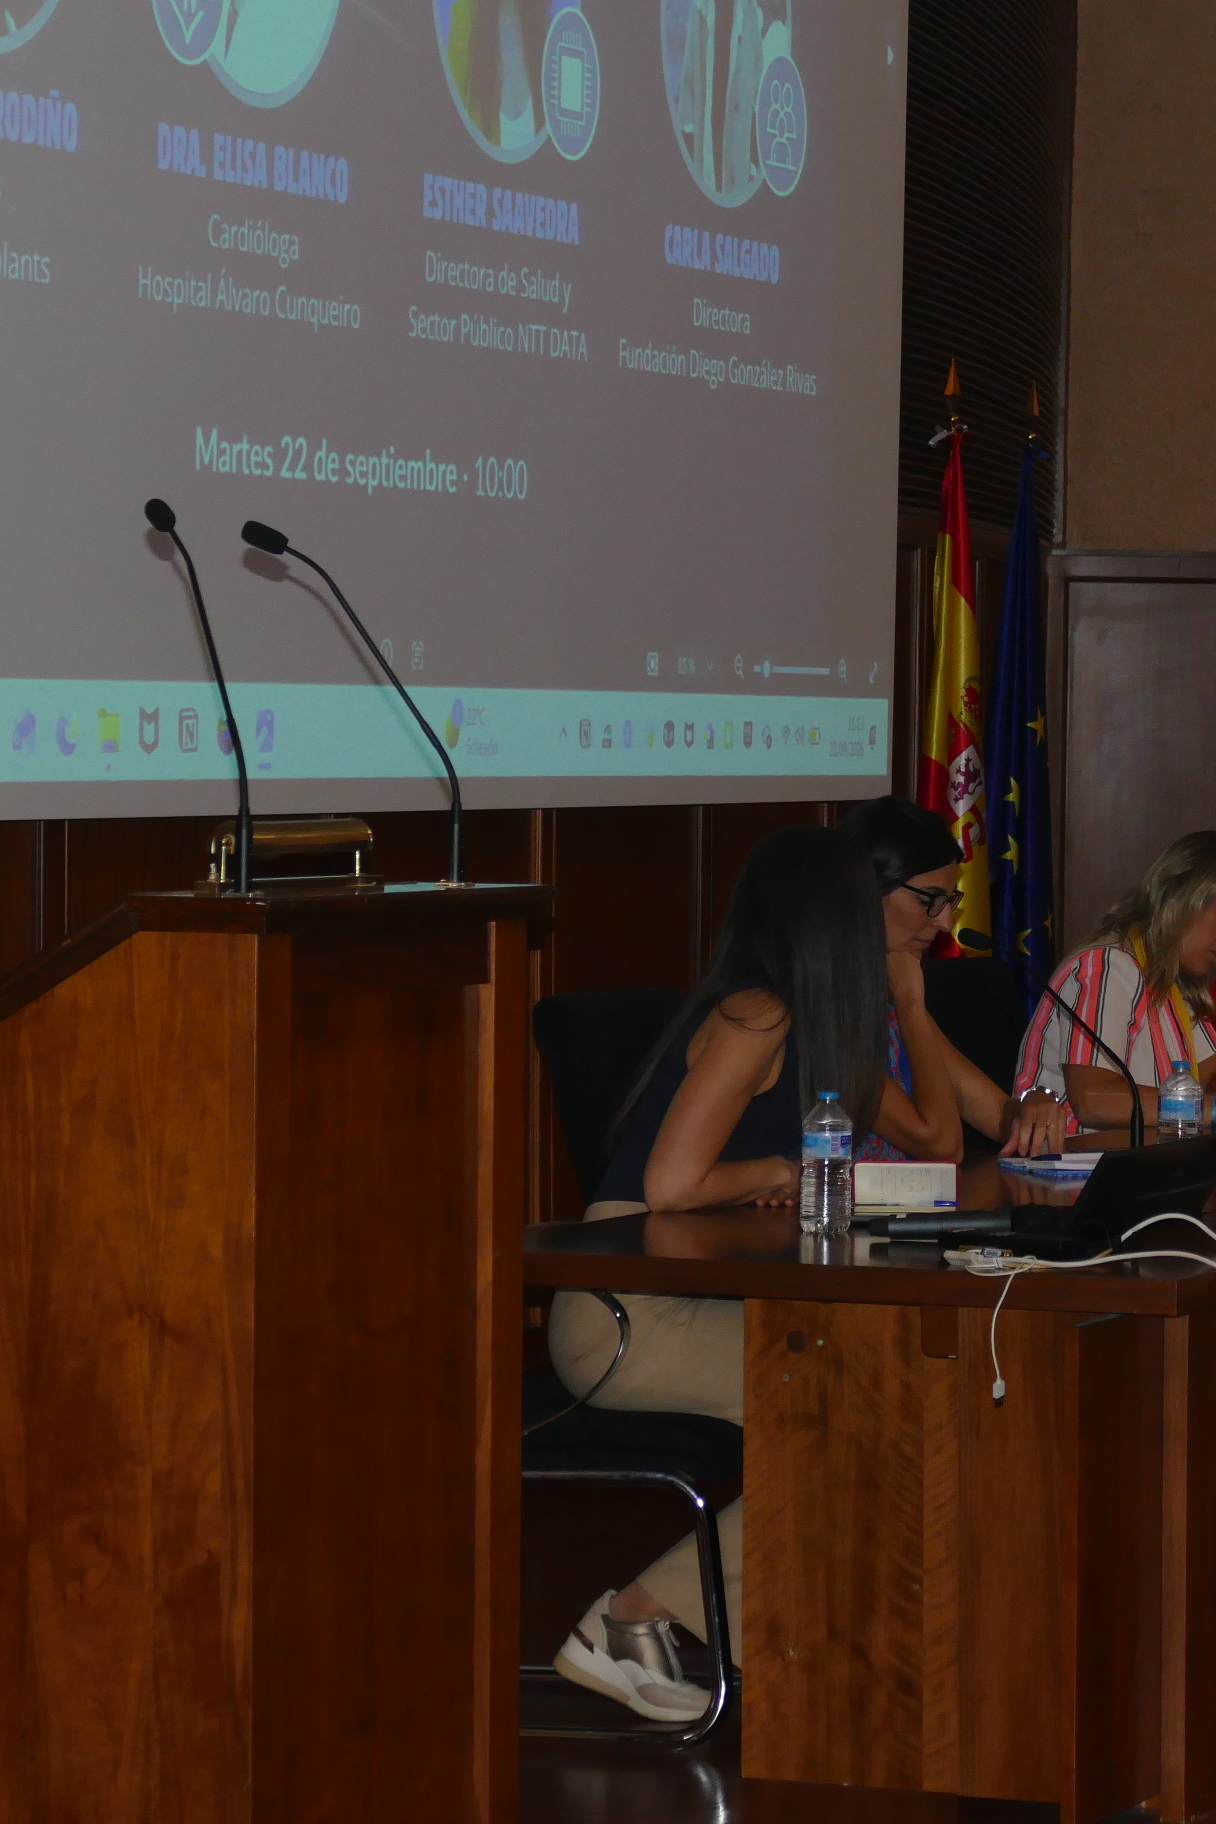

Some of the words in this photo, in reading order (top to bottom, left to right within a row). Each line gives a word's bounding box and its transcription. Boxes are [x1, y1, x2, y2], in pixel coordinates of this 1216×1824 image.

[0, 88, 79, 152] ODIÑO
[157, 122, 207, 177] DRA.
[213, 133, 268, 189] ELISA
[273, 145, 349, 202] BLANCO
[423, 174, 489, 227] ESTHER
[492, 188, 580, 246] SAAVEDRA
[0, 241, 51, 284] lants
[208, 214, 300, 268] Cardióloga
[664, 224, 711, 271] CARLA
[714, 234, 781, 283] SALGADO
[138, 265, 212, 312] Hospital
[216, 268, 271, 315] Álvaro
[275, 286, 362, 332] Cunqueiro
[425, 250, 495, 293] Directora
[498, 269, 517, 296] de
[520, 267, 561, 302] Salud
[562, 280, 573, 313] y
[408, 305, 457, 342] Sector
[460, 313, 514, 351] Público
[518, 322, 547, 355] NTT
[550, 327, 589, 362] DATA
[693, 298, 752, 334] Directora
[618, 338, 686, 377] Fundación
[689, 350, 726, 389] Diego
[728, 355, 784, 391] González
[786, 367, 817, 396] Rivas
[195, 426, 274, 477] Martes
[281, 435, 308, 479] 22
[313, 437, 340, 483] de
[345, 447, 458, 494] septiembre
[476, 457, 528, 499] 10:00
